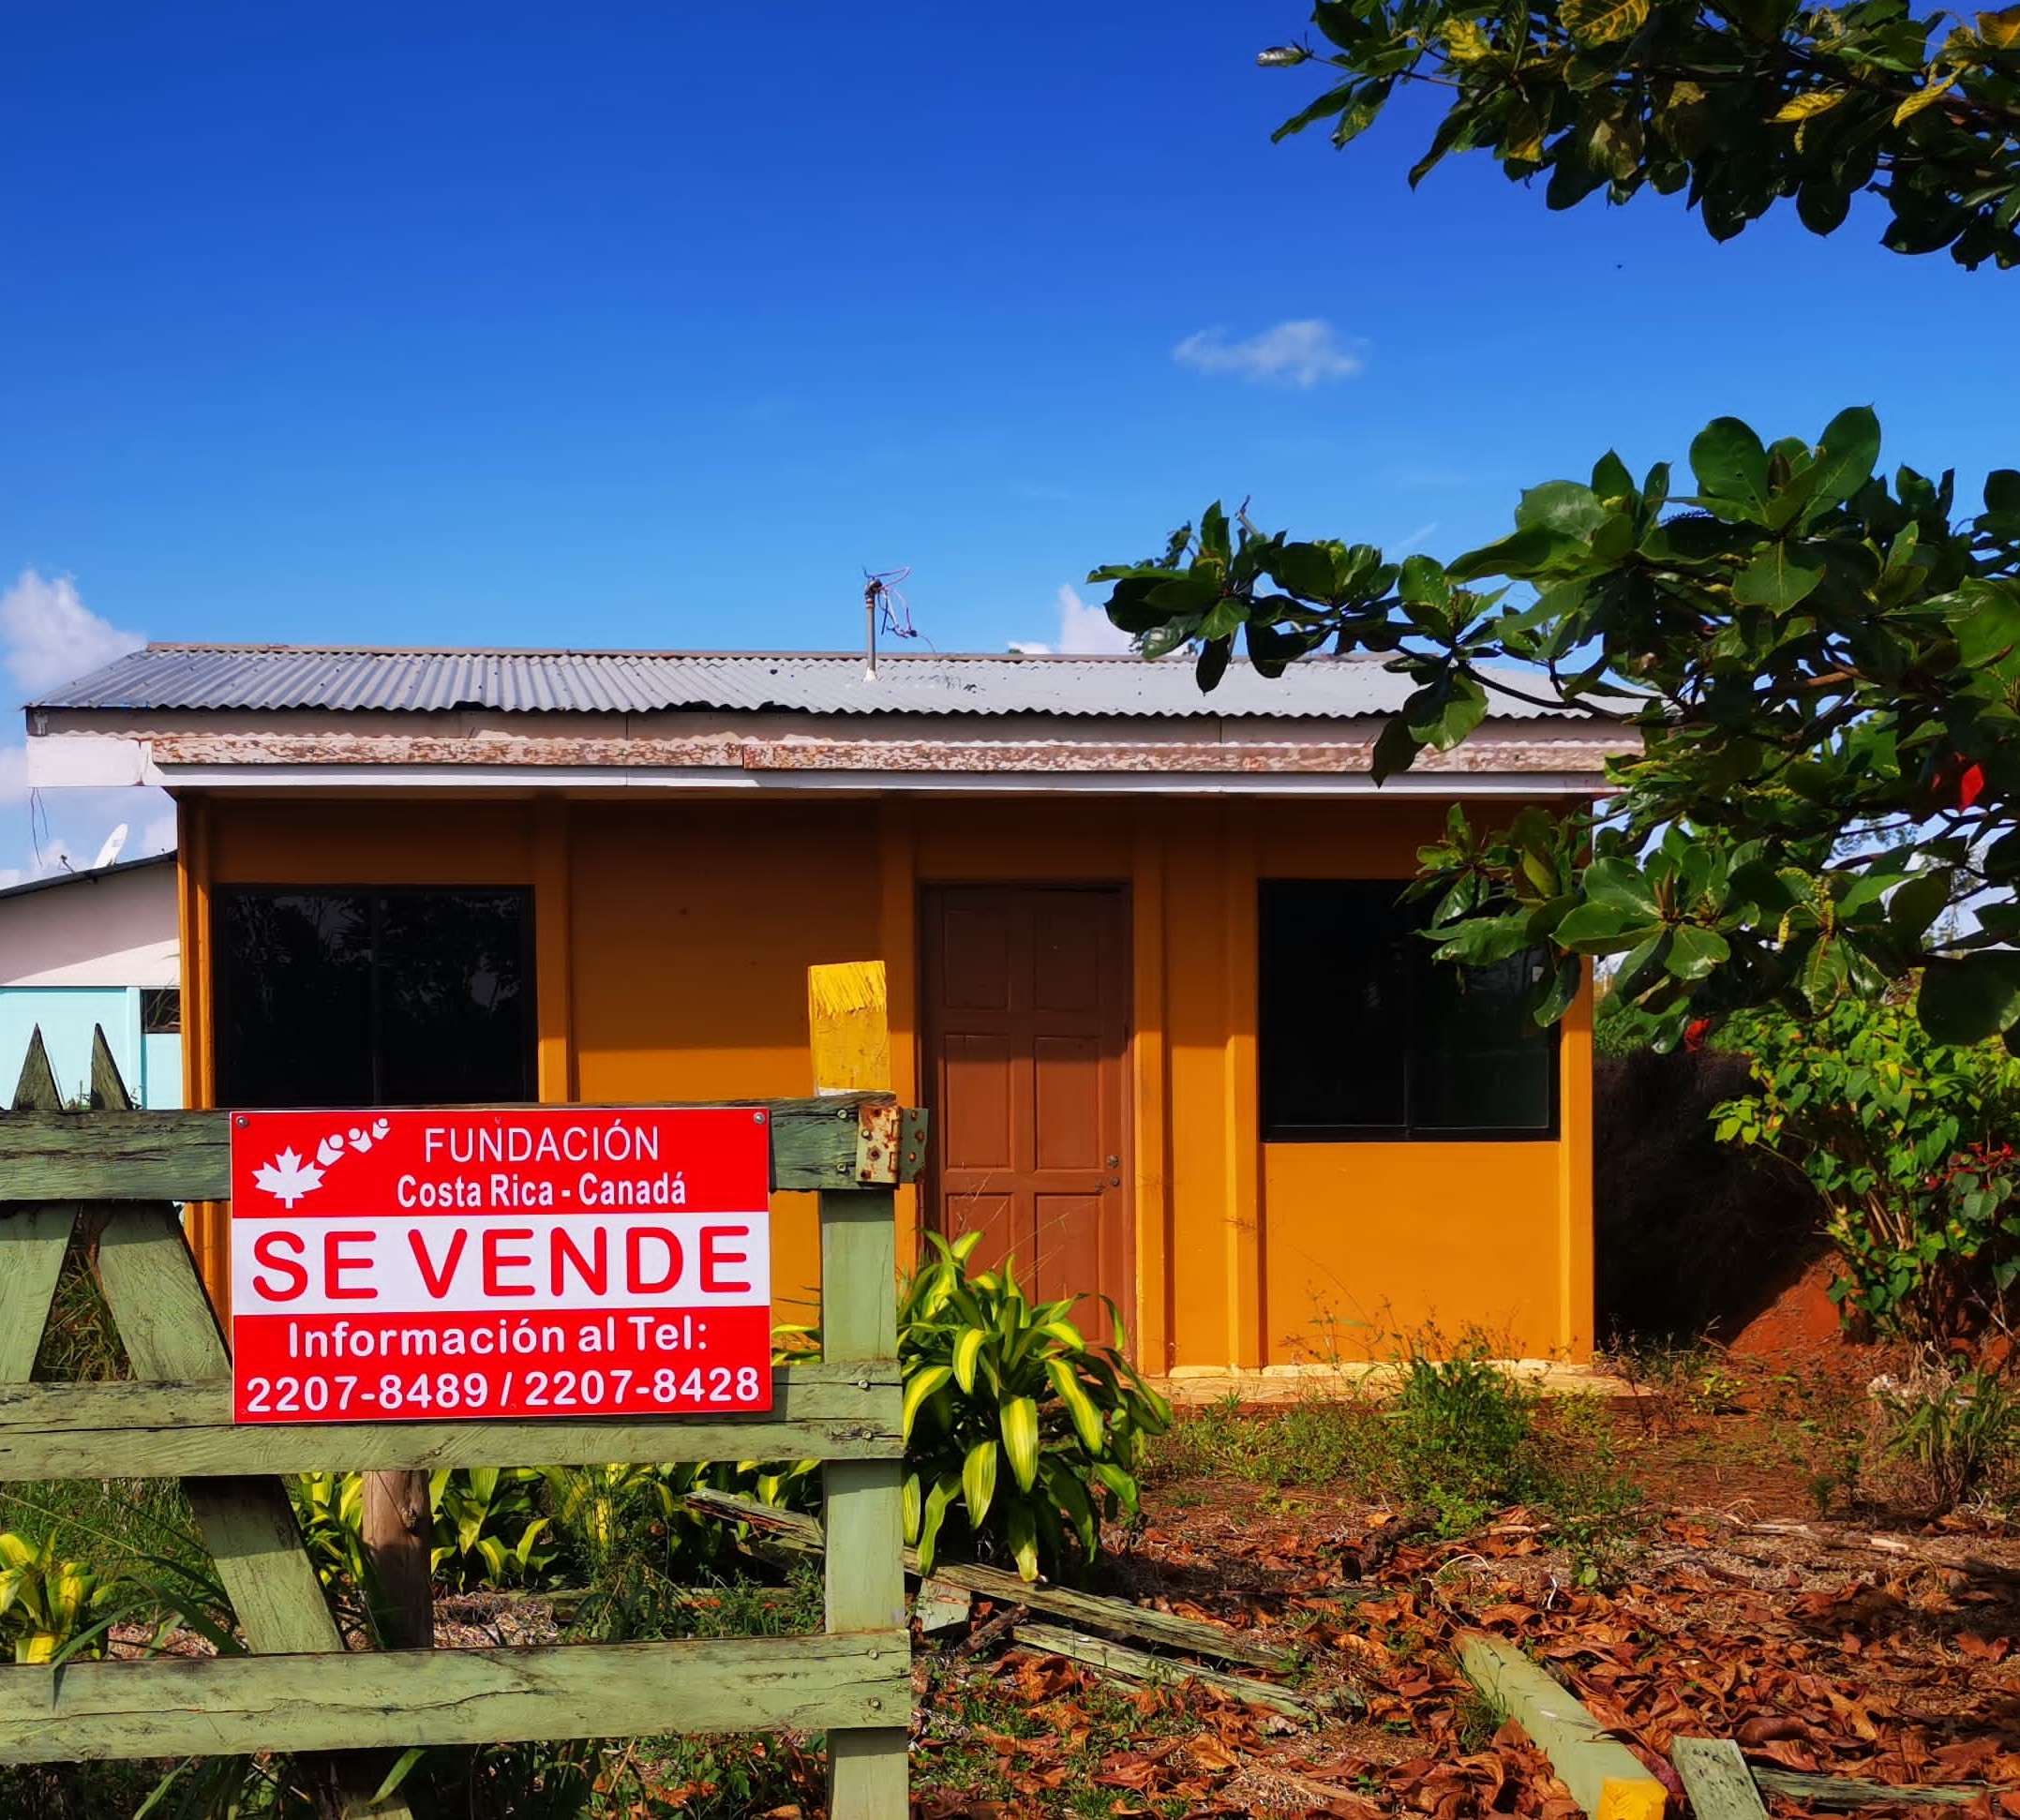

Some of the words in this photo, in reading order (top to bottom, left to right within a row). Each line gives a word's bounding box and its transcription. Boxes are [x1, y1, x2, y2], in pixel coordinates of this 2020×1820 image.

[426, 1119, 657, 1162] FUNDACIÓN
[398, 1175, 481, 1207] Costa
[491, 1174, 552, 1206] Rica
[579, 1171, 685, 1205] Canadá
[253, 1231, 378, 1302] SE
[408, 1226, 751, 1299] VENDE
[290, 1319, 564, 1357] Información
[578, 1317, 614, 1351] al
[628, 1316, 706, 1350] Tel:
[247, 1373, 487, 1411] 2207-8489
[501, 1372, 512, 1406] /
[526, 1367, 758, 1405] 2207-8428
